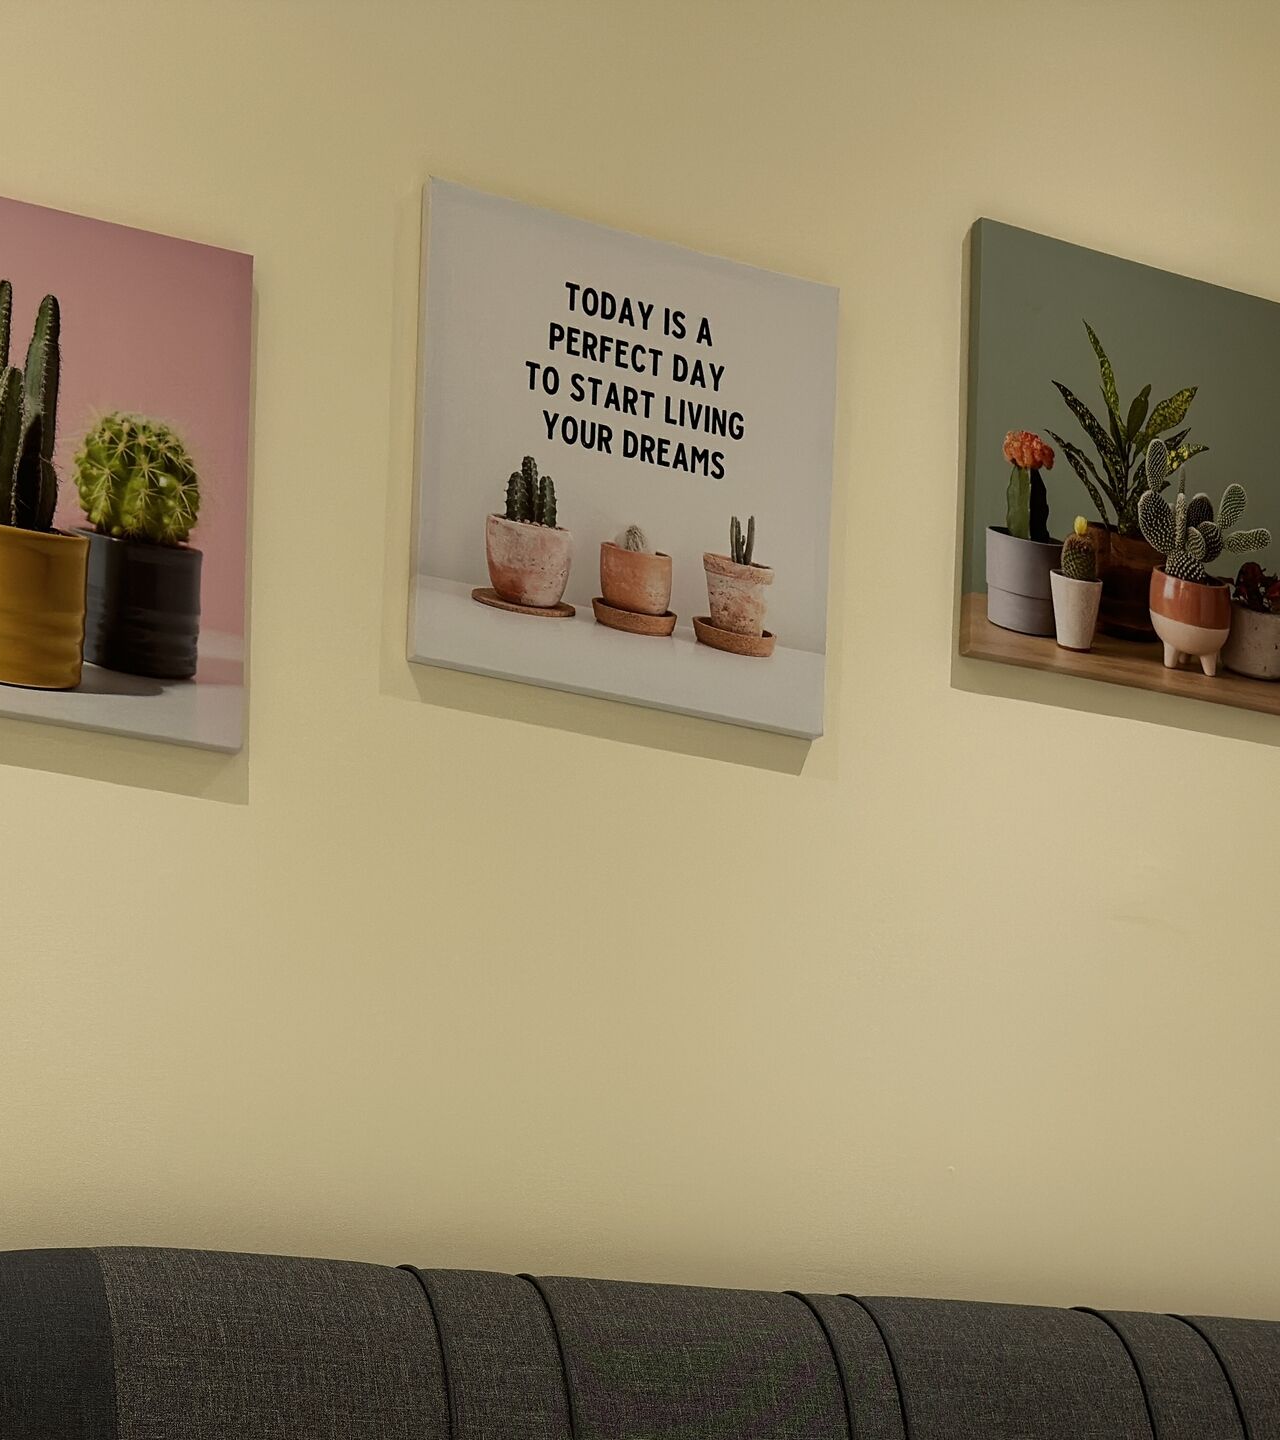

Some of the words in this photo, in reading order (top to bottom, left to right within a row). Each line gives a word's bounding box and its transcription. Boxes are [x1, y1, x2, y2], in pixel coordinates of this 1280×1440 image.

[565, 281, 654, 331] TODAY
[663, 308, 687, 340] IS
[696, 317, 713, 347] A
[548, 322, 663, 377] PERFECT
[672, 354, 725, 392] DAY
[525, 360, 560, 396] TO
[570, 373, 655, 419] START
[664, 396, 745, 441] LIVING
[542, 410, 613, 455] YOUR
[622, 429, 725, 480] DREAMS
